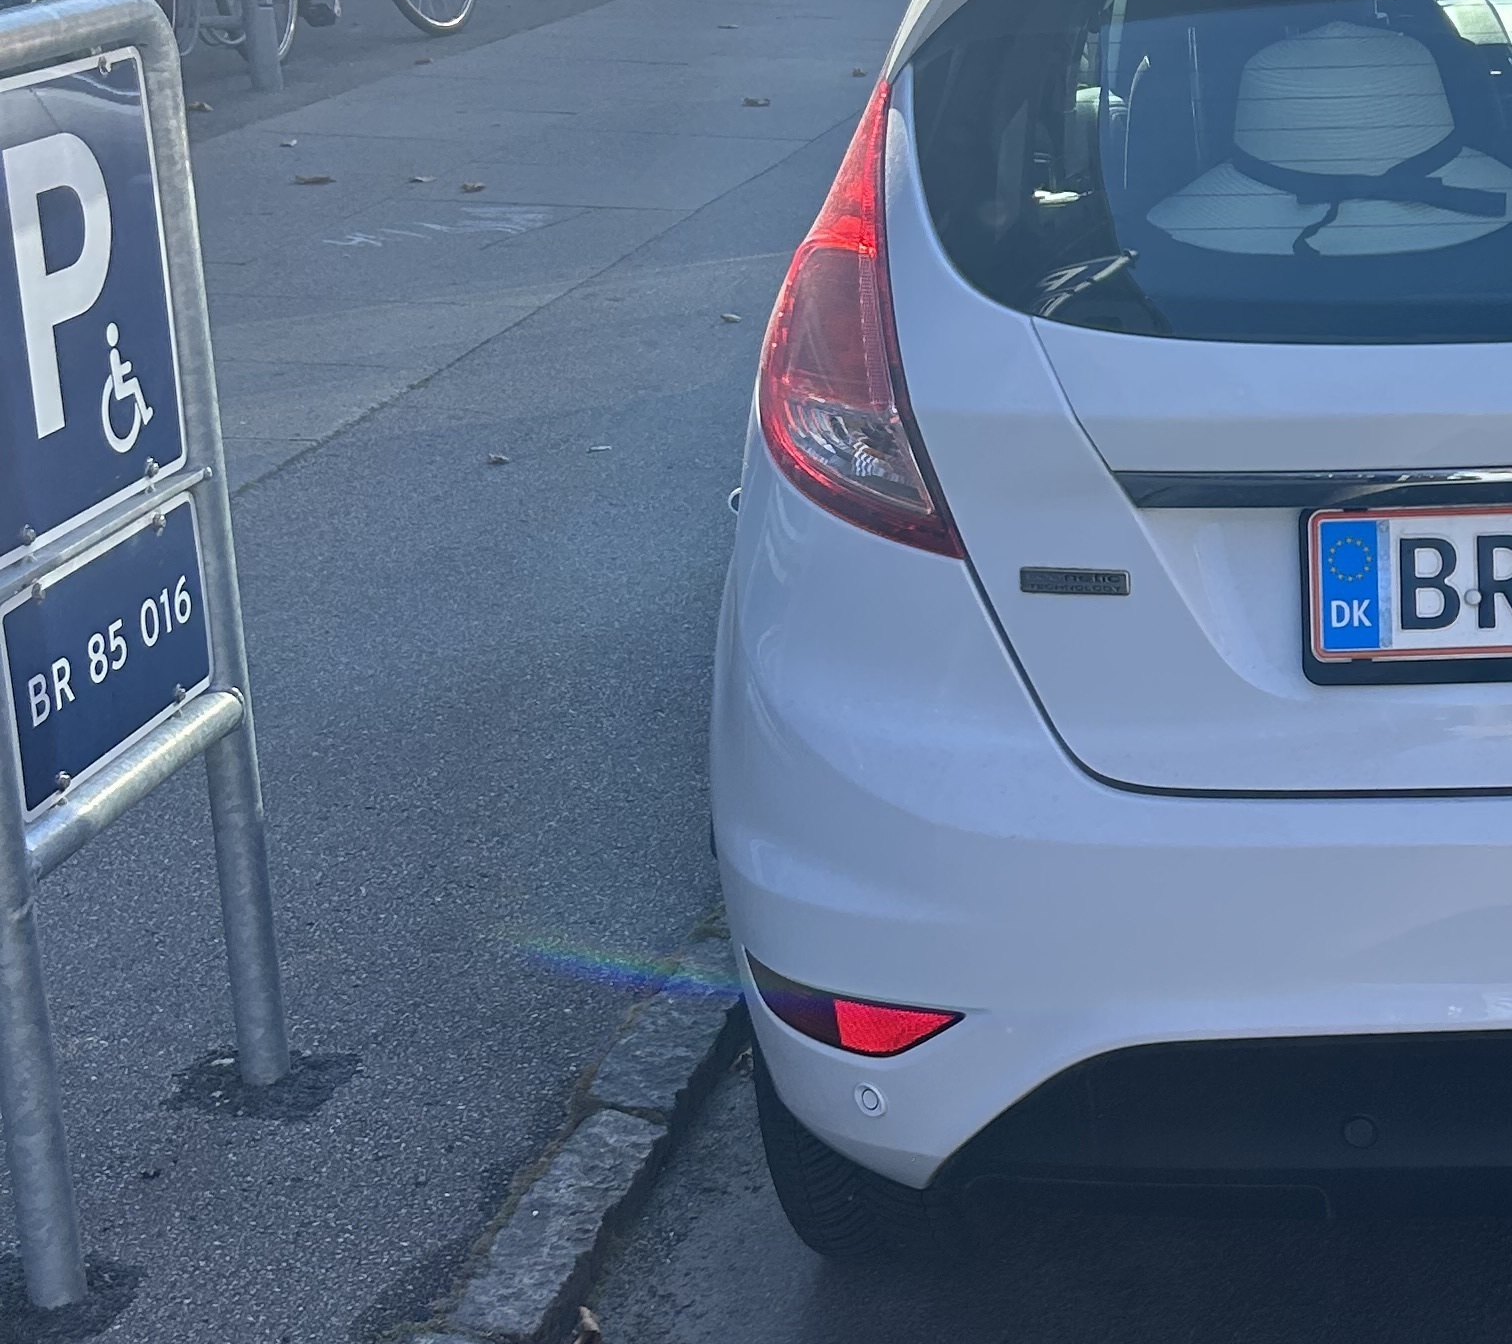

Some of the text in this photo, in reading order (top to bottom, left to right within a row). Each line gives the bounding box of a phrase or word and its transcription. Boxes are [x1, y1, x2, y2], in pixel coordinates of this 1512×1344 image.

[2, 132, 113, 440] P
[27, 574, 192, 728] BR 85 016
[1330, 599, 1373, 628] DK
